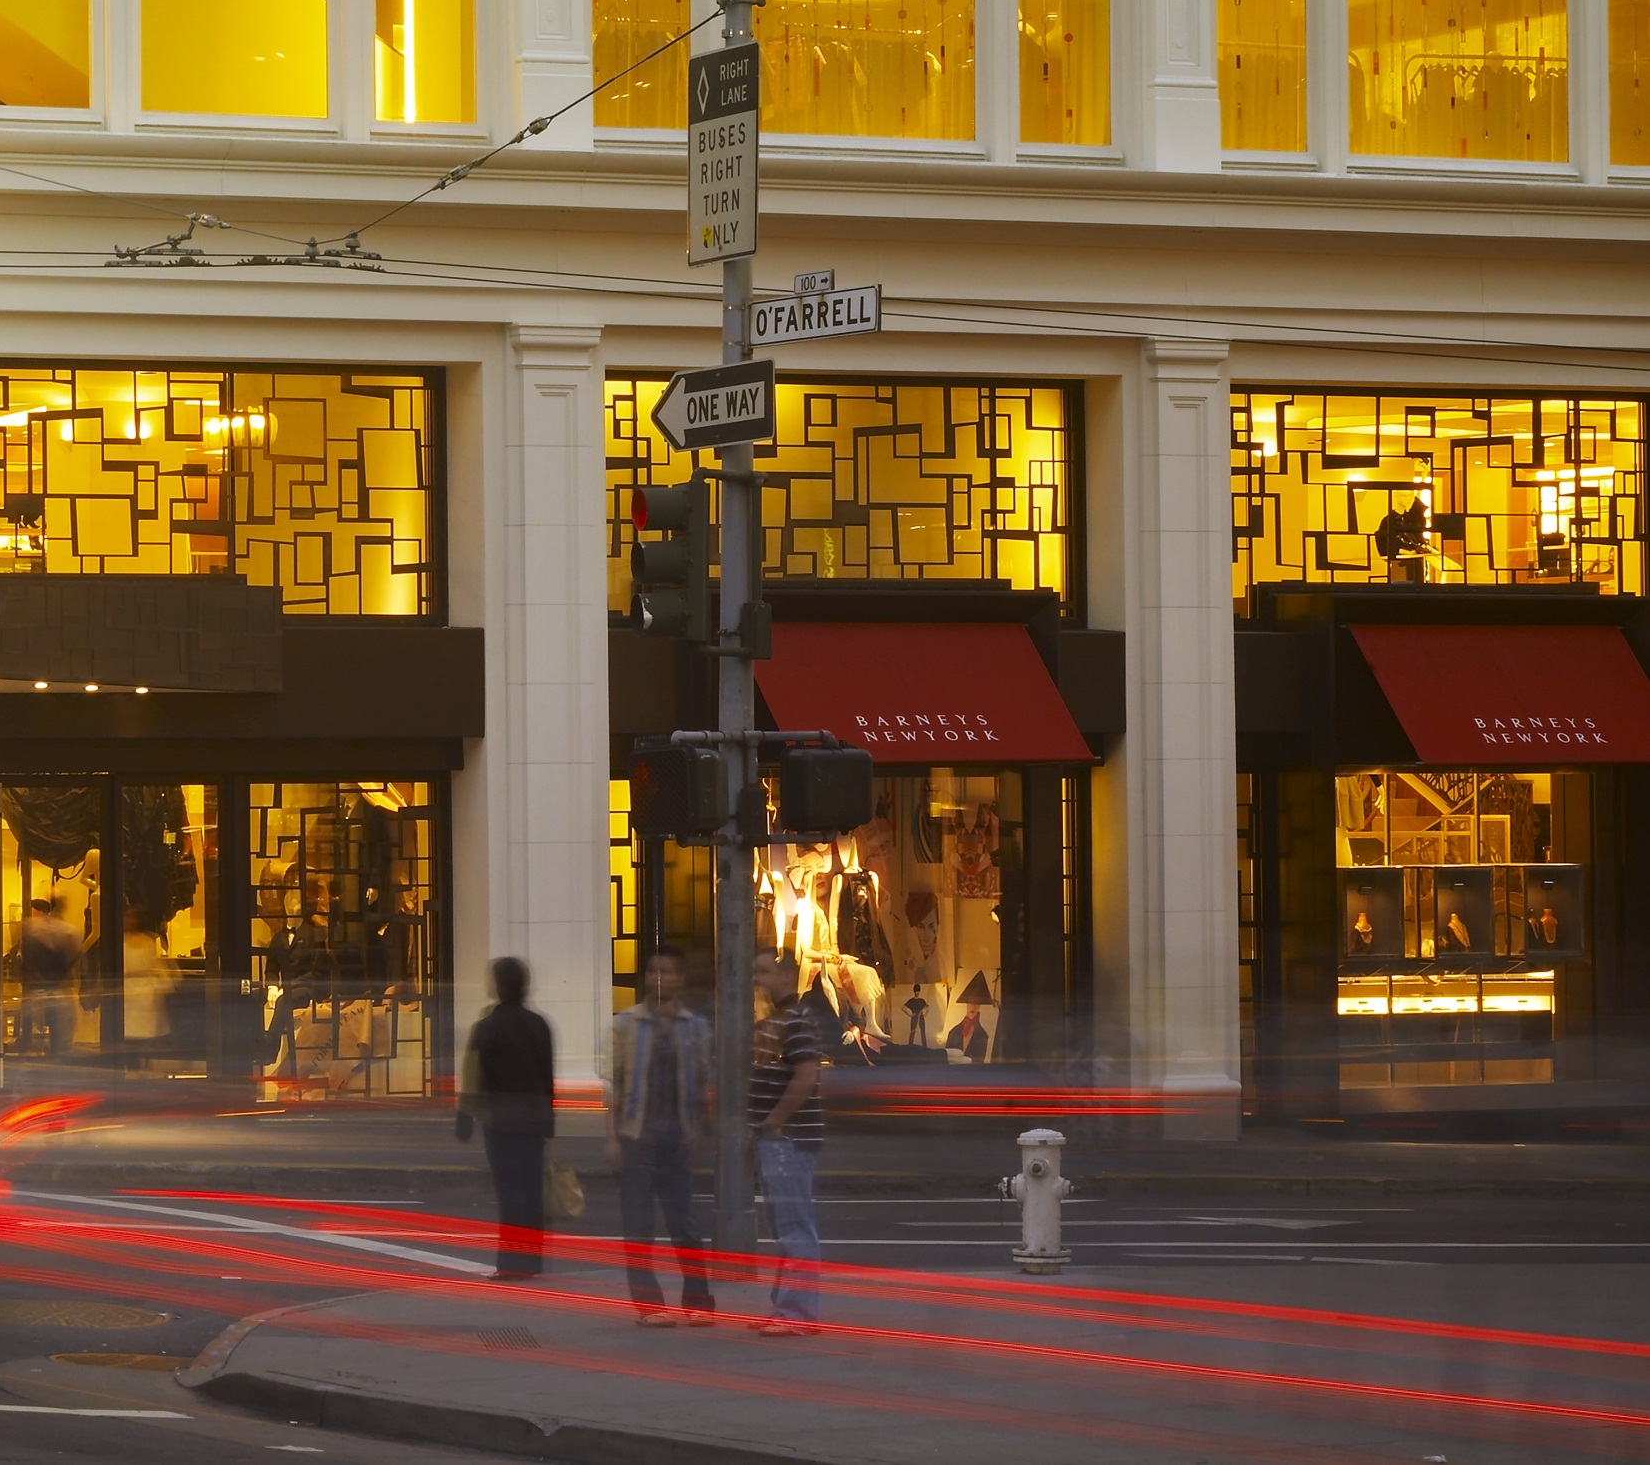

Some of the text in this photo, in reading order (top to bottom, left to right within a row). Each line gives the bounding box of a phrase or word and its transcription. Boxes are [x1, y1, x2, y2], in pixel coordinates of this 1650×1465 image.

[719, 58, 750, 82] RIGHT
[721, 84, 748, 106] LANE
[698, 122, 746, 154] BUSES
[701, 155, 743, 185] RIGHT
[703, 188, 741, 217] TURN
[703, 220, 739, 249] NLY
[800, 275, 817, 291] 100
[755, 295, 871, 337] O'FARRELL
[686, 386, 760, 425] ONE WAY
[855, 714, 988, 727] BARNEYS
[1474, 717, 1596, 729] BARNEYS
